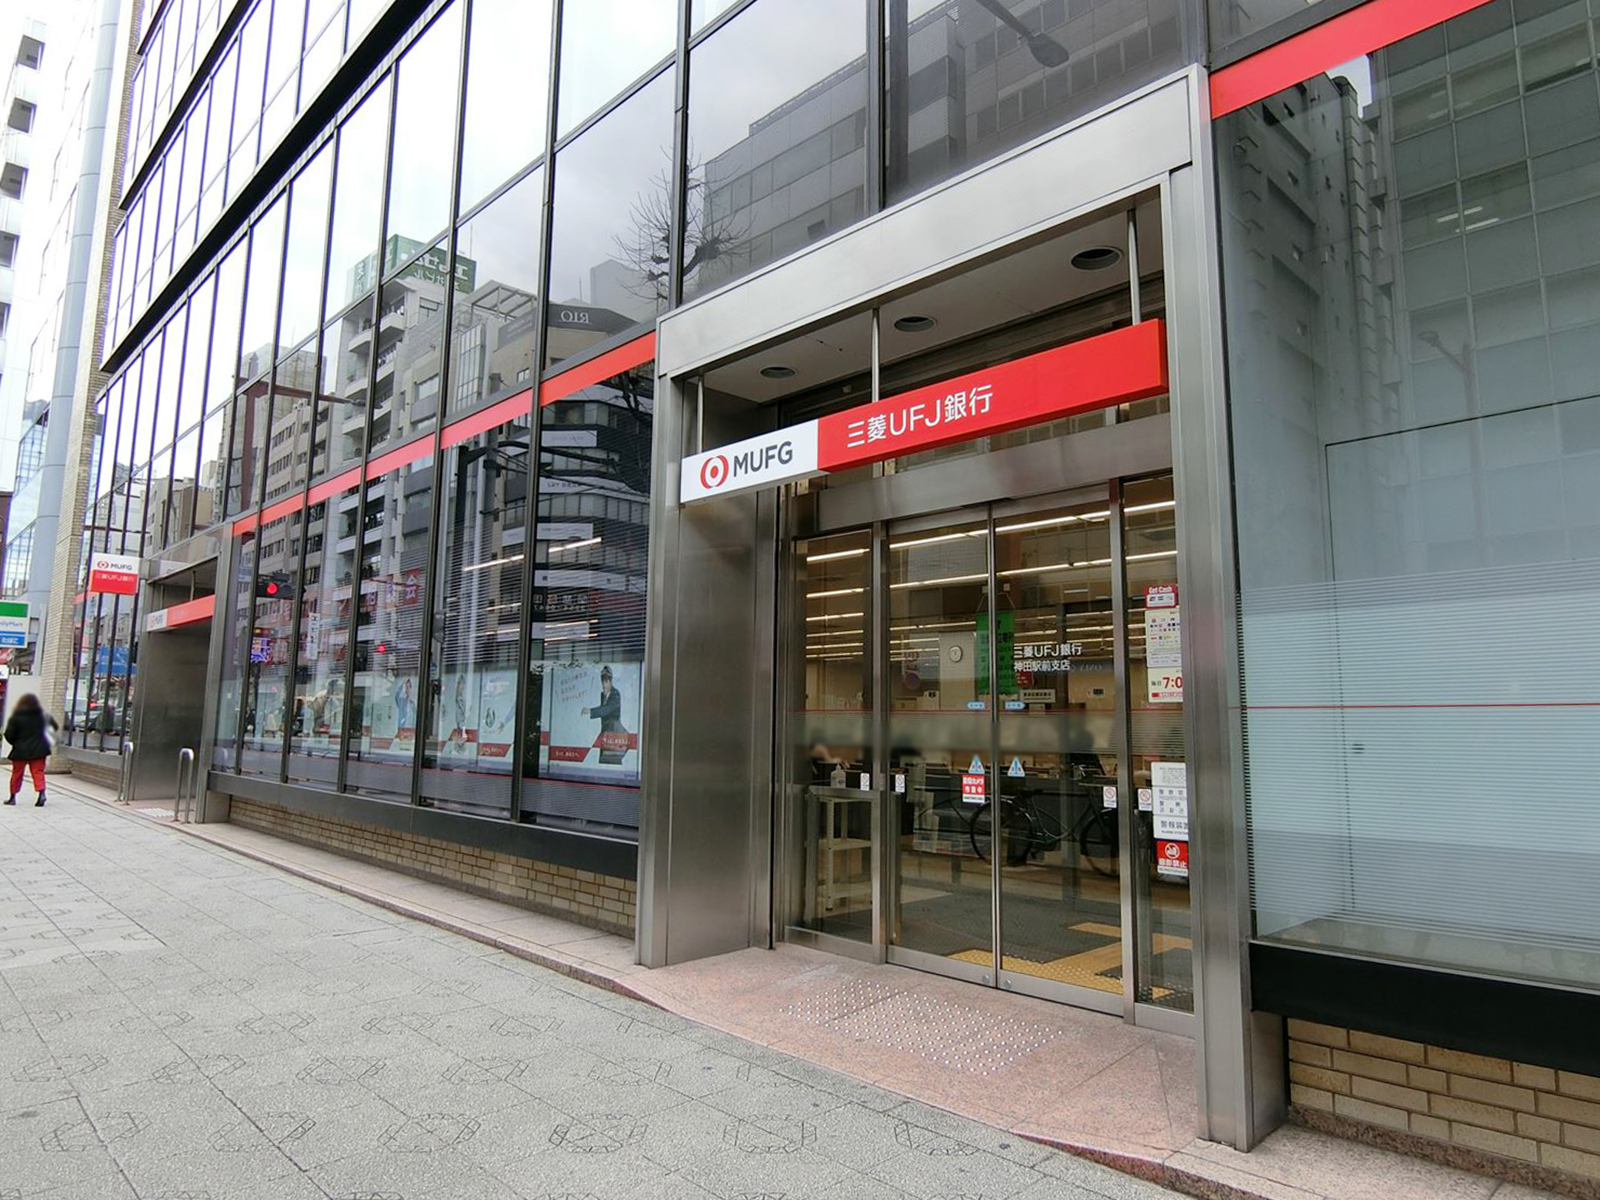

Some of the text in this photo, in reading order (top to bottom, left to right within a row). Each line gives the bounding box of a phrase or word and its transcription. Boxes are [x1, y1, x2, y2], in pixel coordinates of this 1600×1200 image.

[847, 384, 993, 448] 三菱UFJ銀行
[733, 440, 793, 478] MUFG
[110, 562, 133, 571] MUFG
[1013, 643, 1082, 659] 三菱UFJ銀行
[1013, 659, 1071, 672] 神田駅前支店
